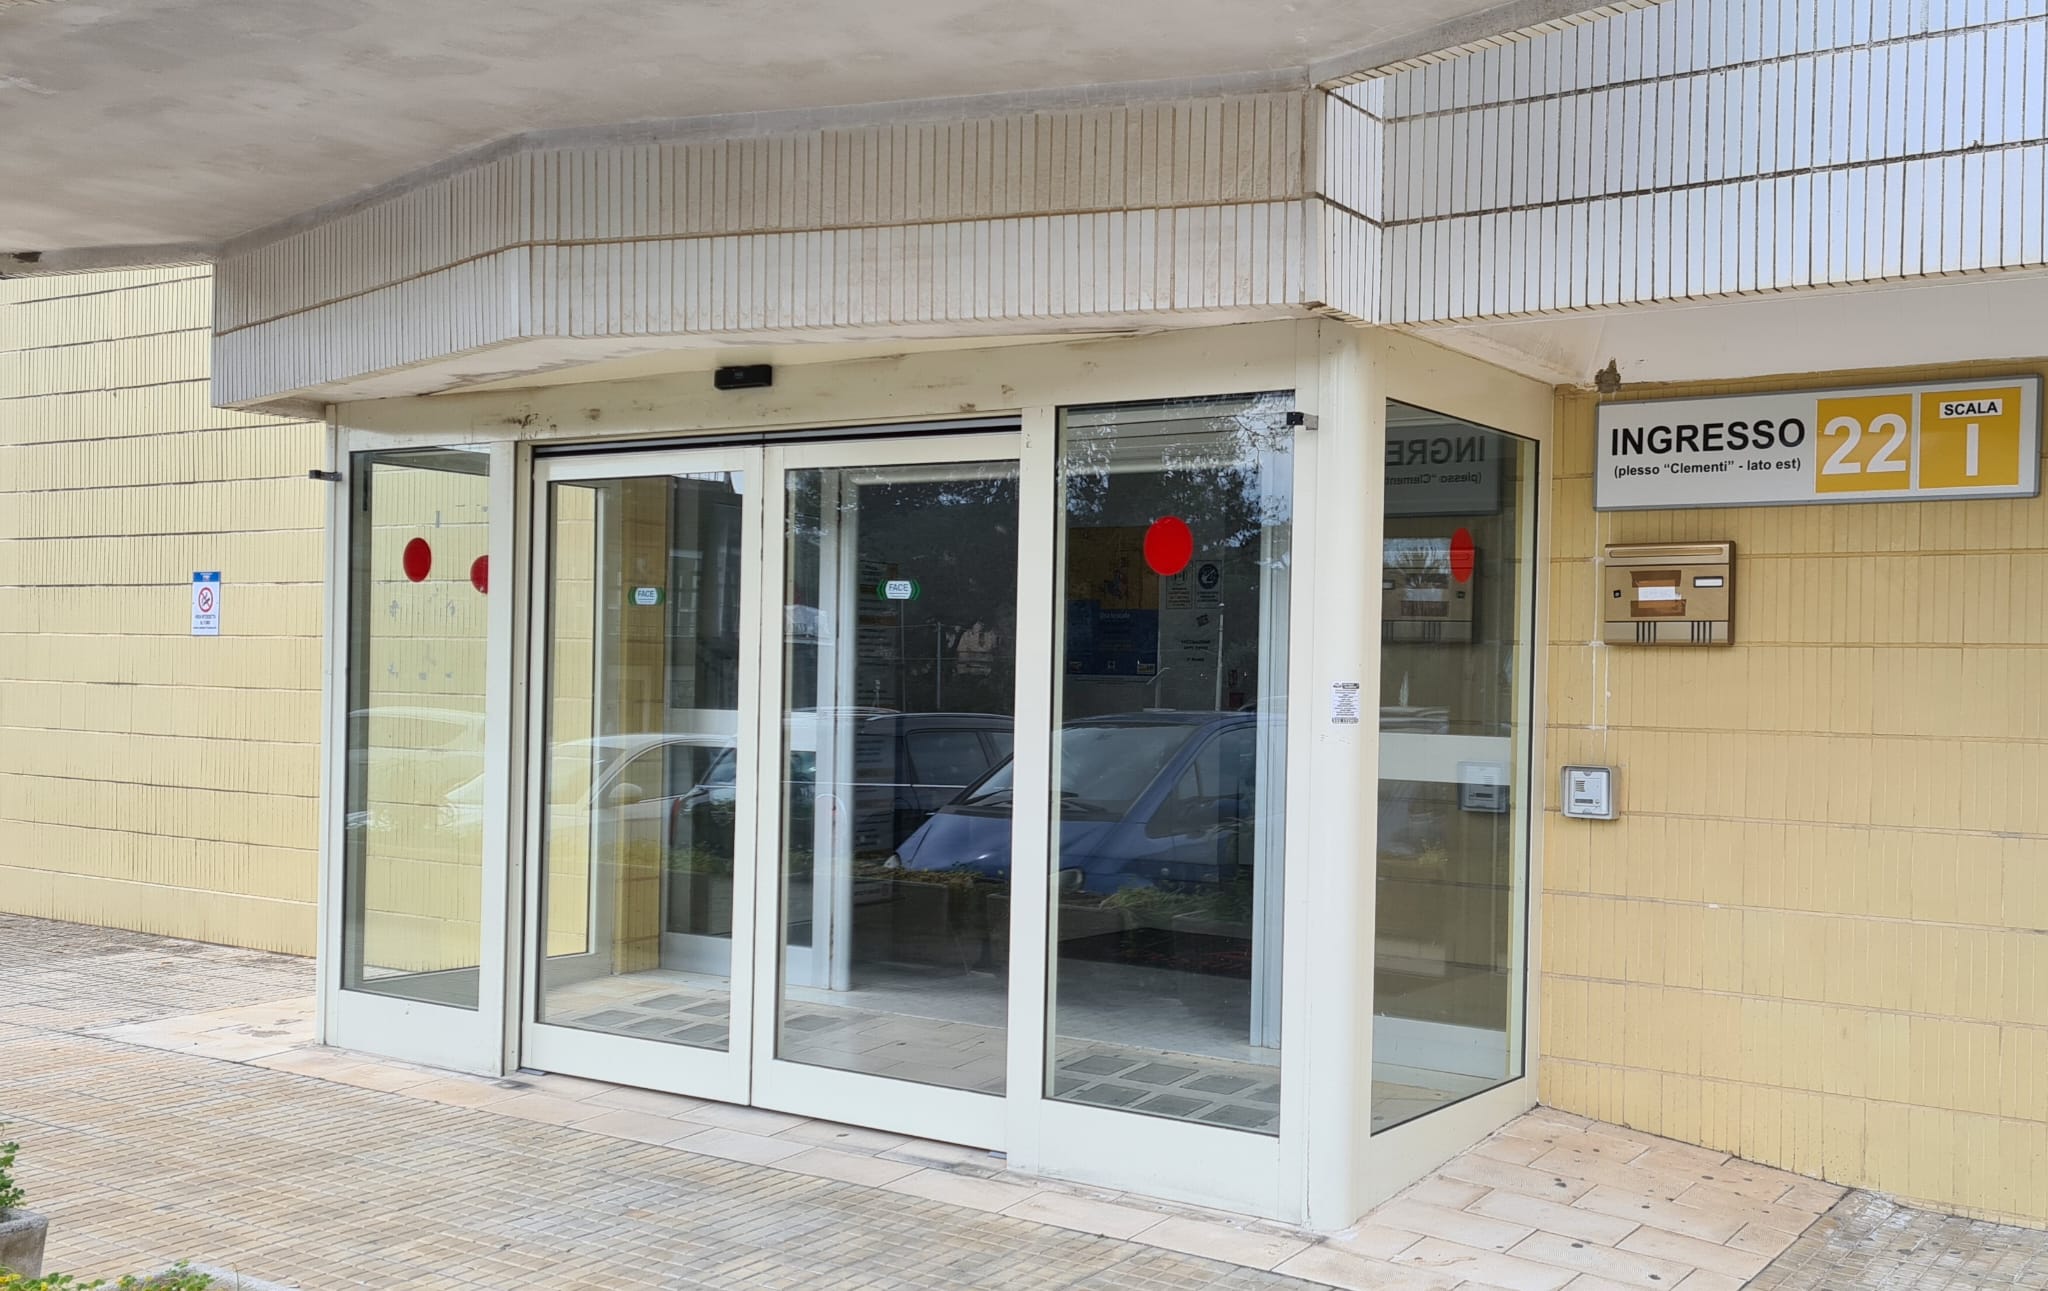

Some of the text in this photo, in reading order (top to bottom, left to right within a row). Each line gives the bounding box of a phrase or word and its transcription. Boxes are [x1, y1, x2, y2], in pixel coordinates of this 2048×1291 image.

[1943, 401, 1998, 416] SCALA
[1611, 418, 1806, 456] INGRESSO
[1822, 413, 1907, 475] 22
[1614, 464, 1660, 479] (plesso
[1664, 460, 1734, 475] “Clementi”
[1747, 459, 1772, 471] lato
[1775, 458, 1801, 472] est)
[889, 583, 909, 592] FACE
